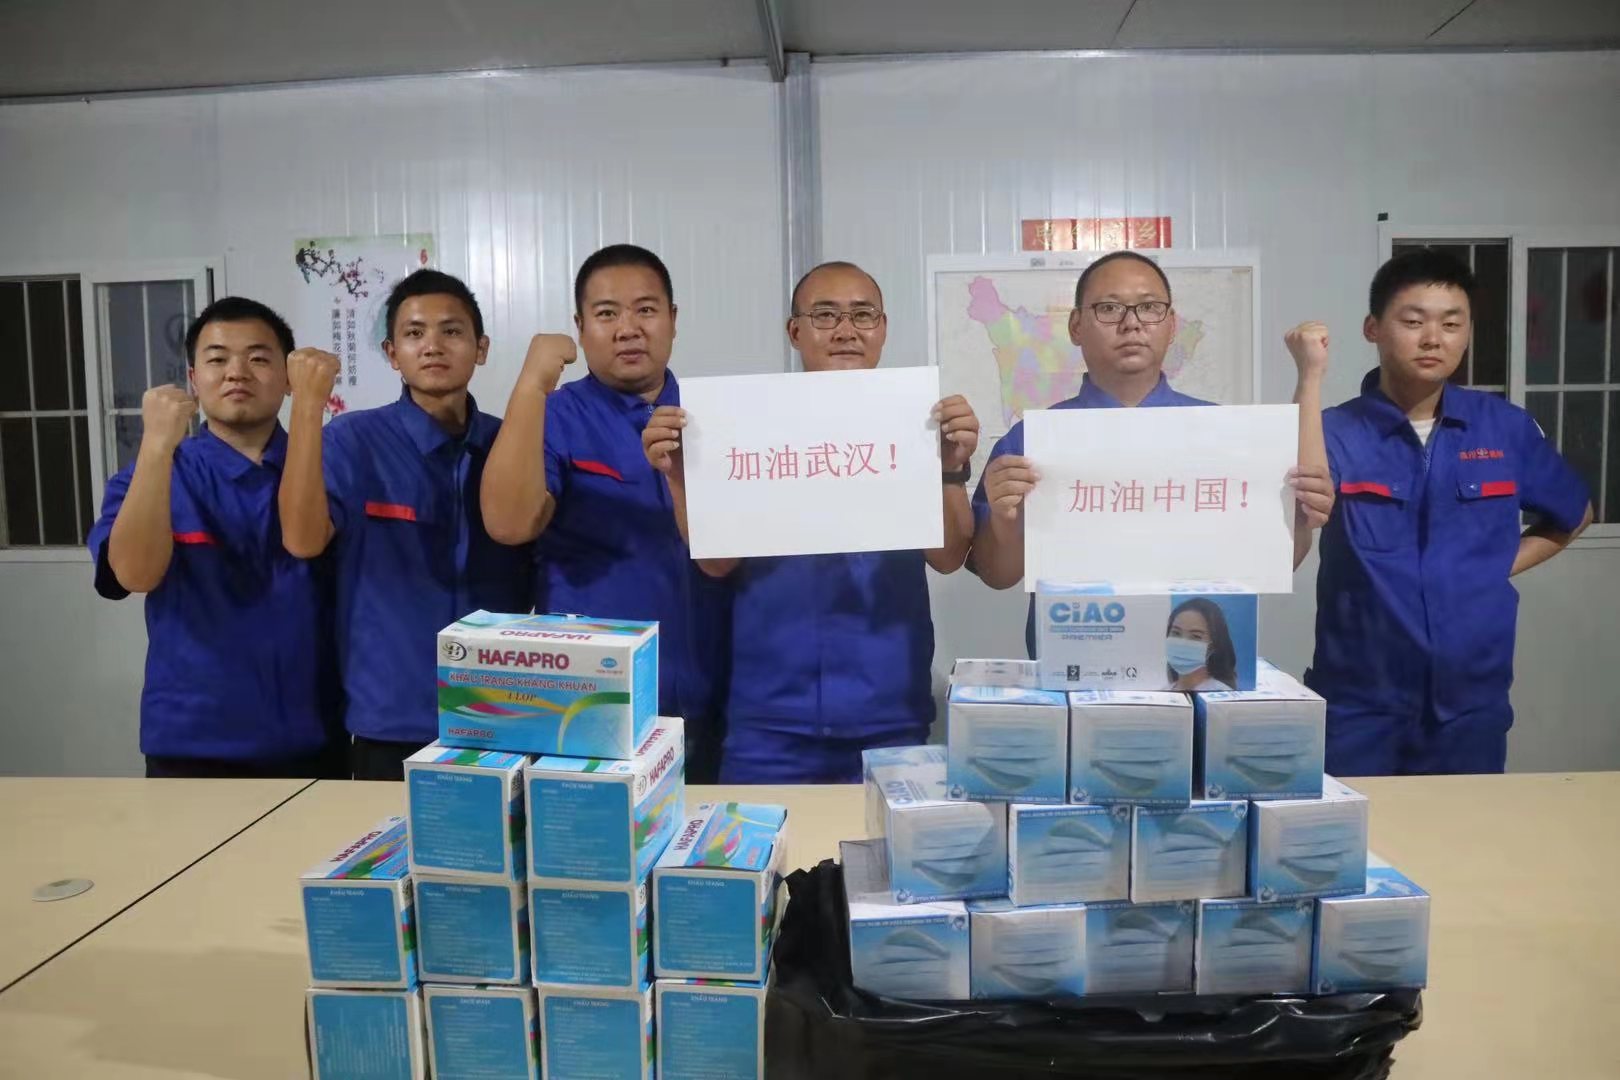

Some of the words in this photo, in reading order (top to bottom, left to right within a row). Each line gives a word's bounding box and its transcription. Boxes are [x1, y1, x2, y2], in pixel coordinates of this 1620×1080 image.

[726, 441, 897, 481] 加油武汉！
[1069, 477, 1248, 513] 加油中国！
[478, 648, 570, 670] HAFAPRO
[447, 727, 495, 739] HAFAPRO
